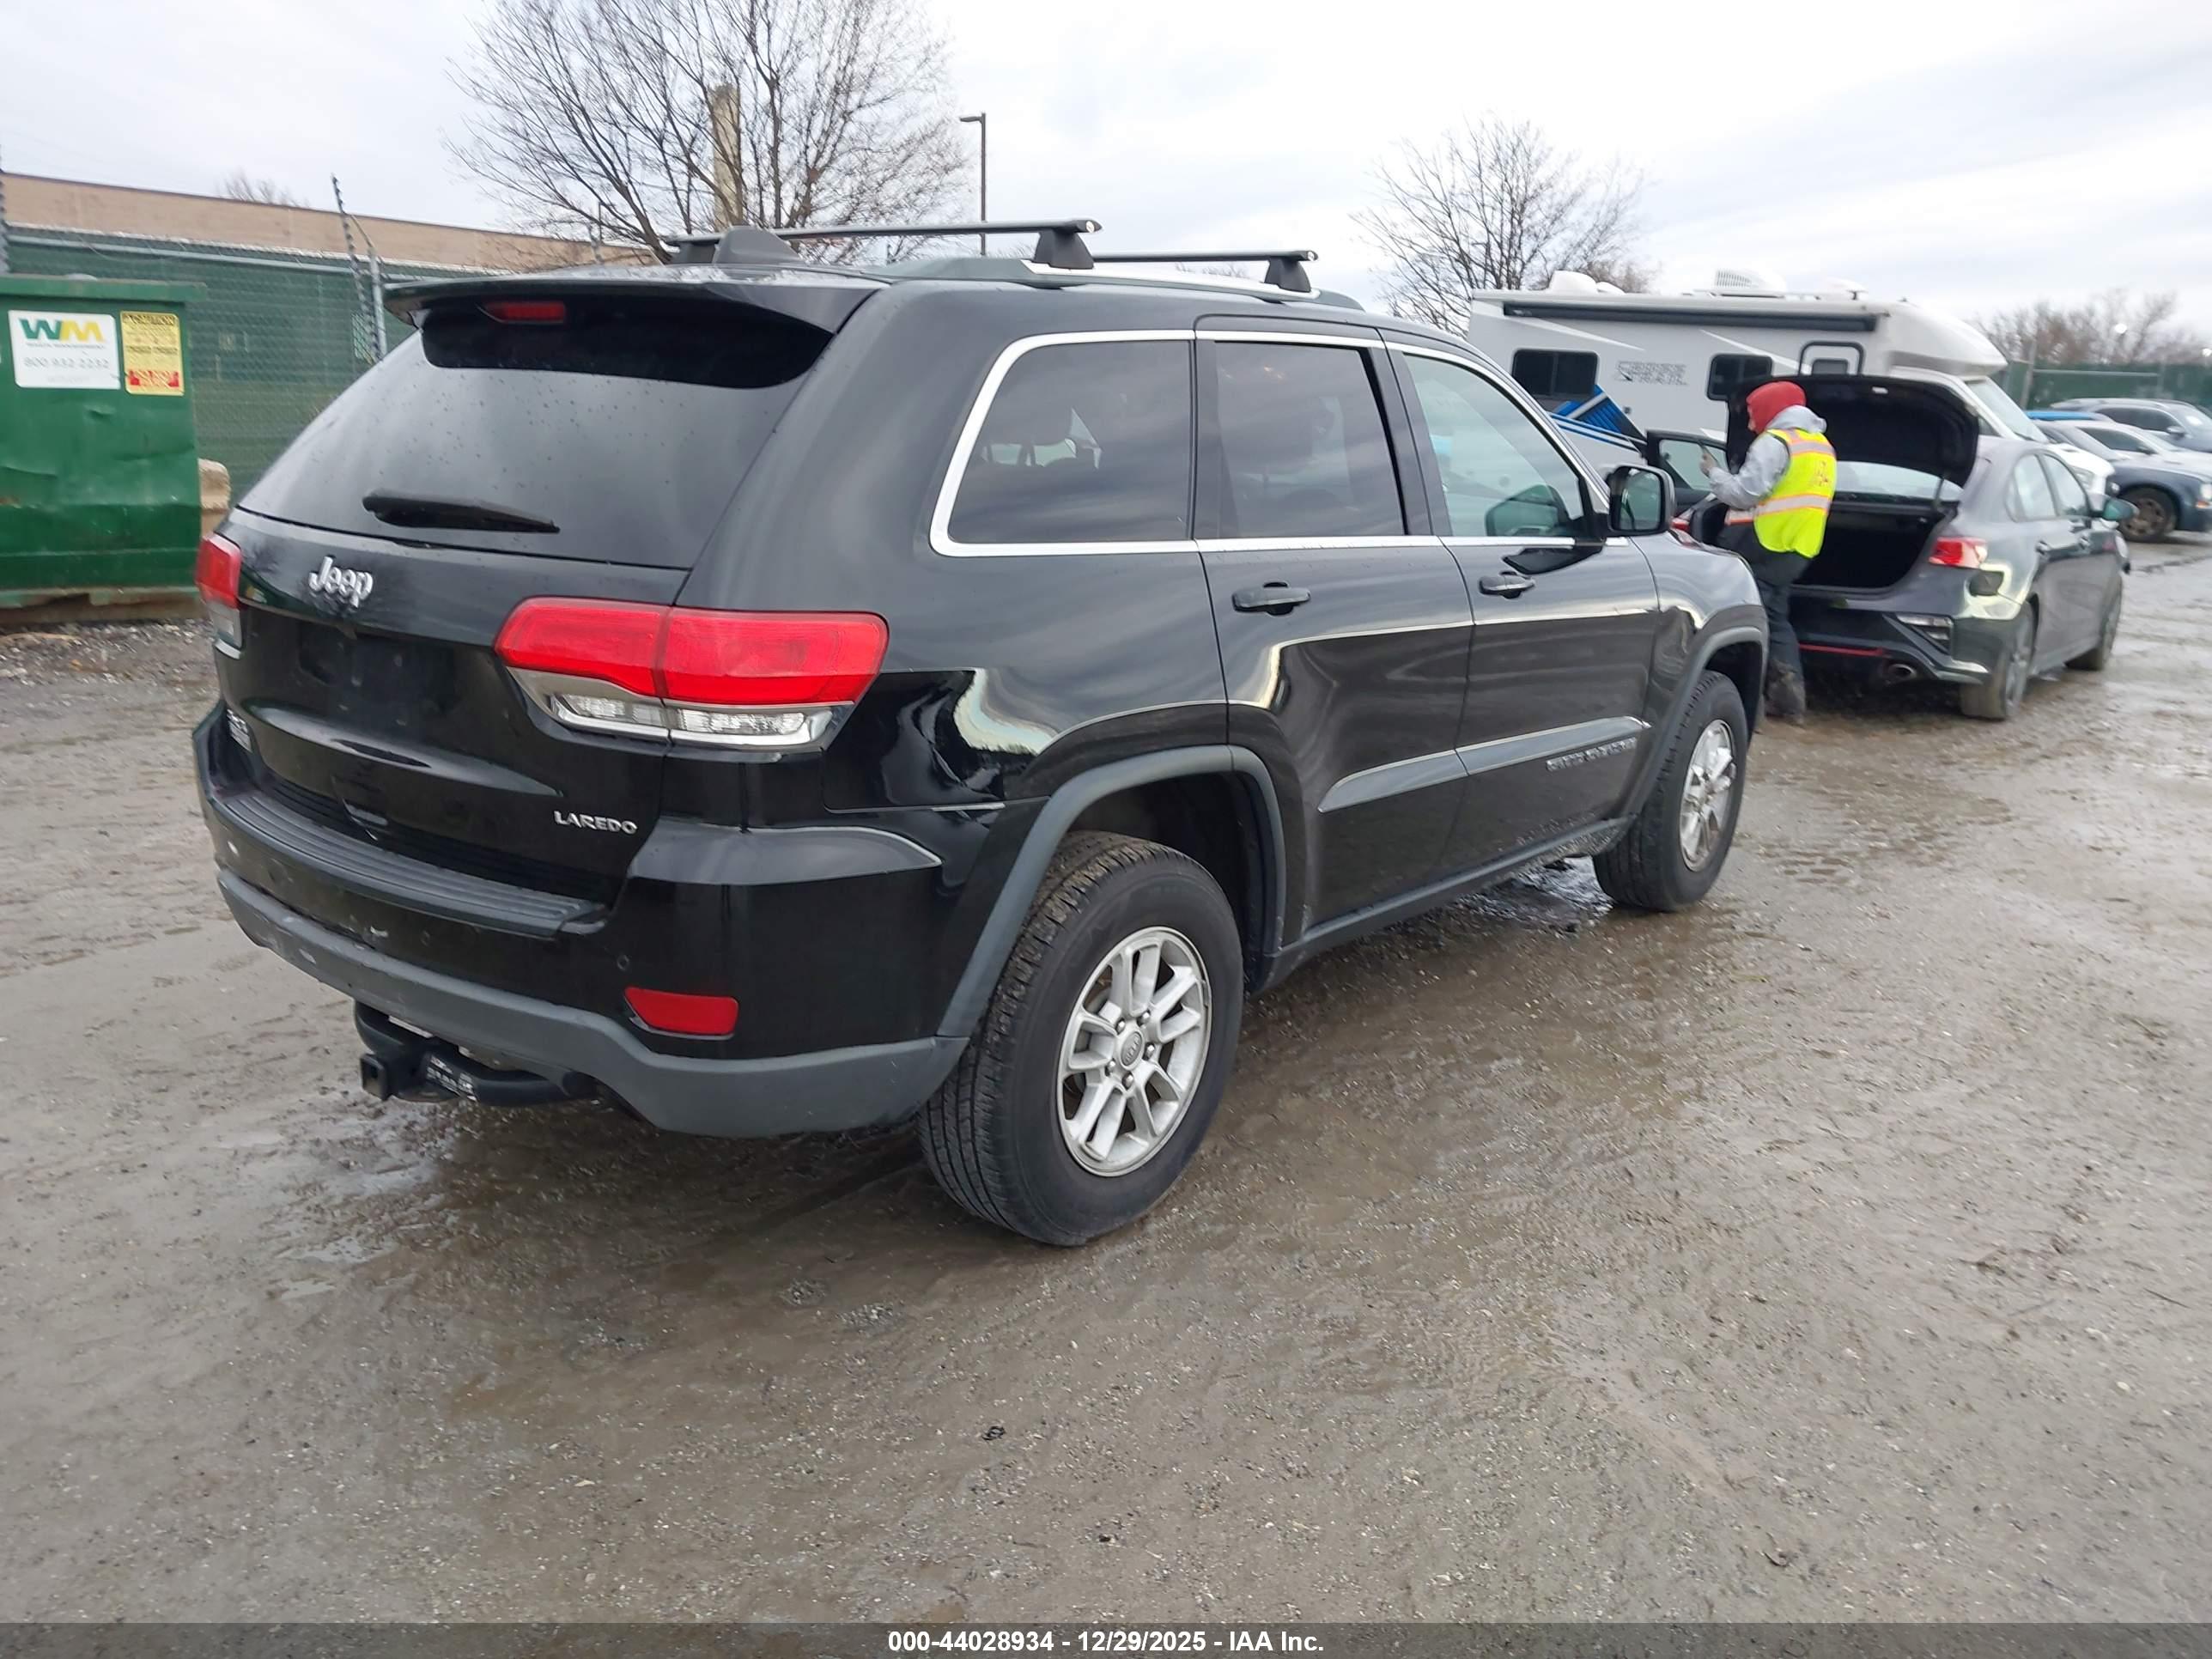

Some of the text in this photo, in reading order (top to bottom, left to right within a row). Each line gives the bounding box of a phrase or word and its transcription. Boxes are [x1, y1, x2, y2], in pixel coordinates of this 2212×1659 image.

[19, 319, 104, 342] WM
[309, 556, 373, 608] Jeep
[553, 811, 638, 835] LAREDO
